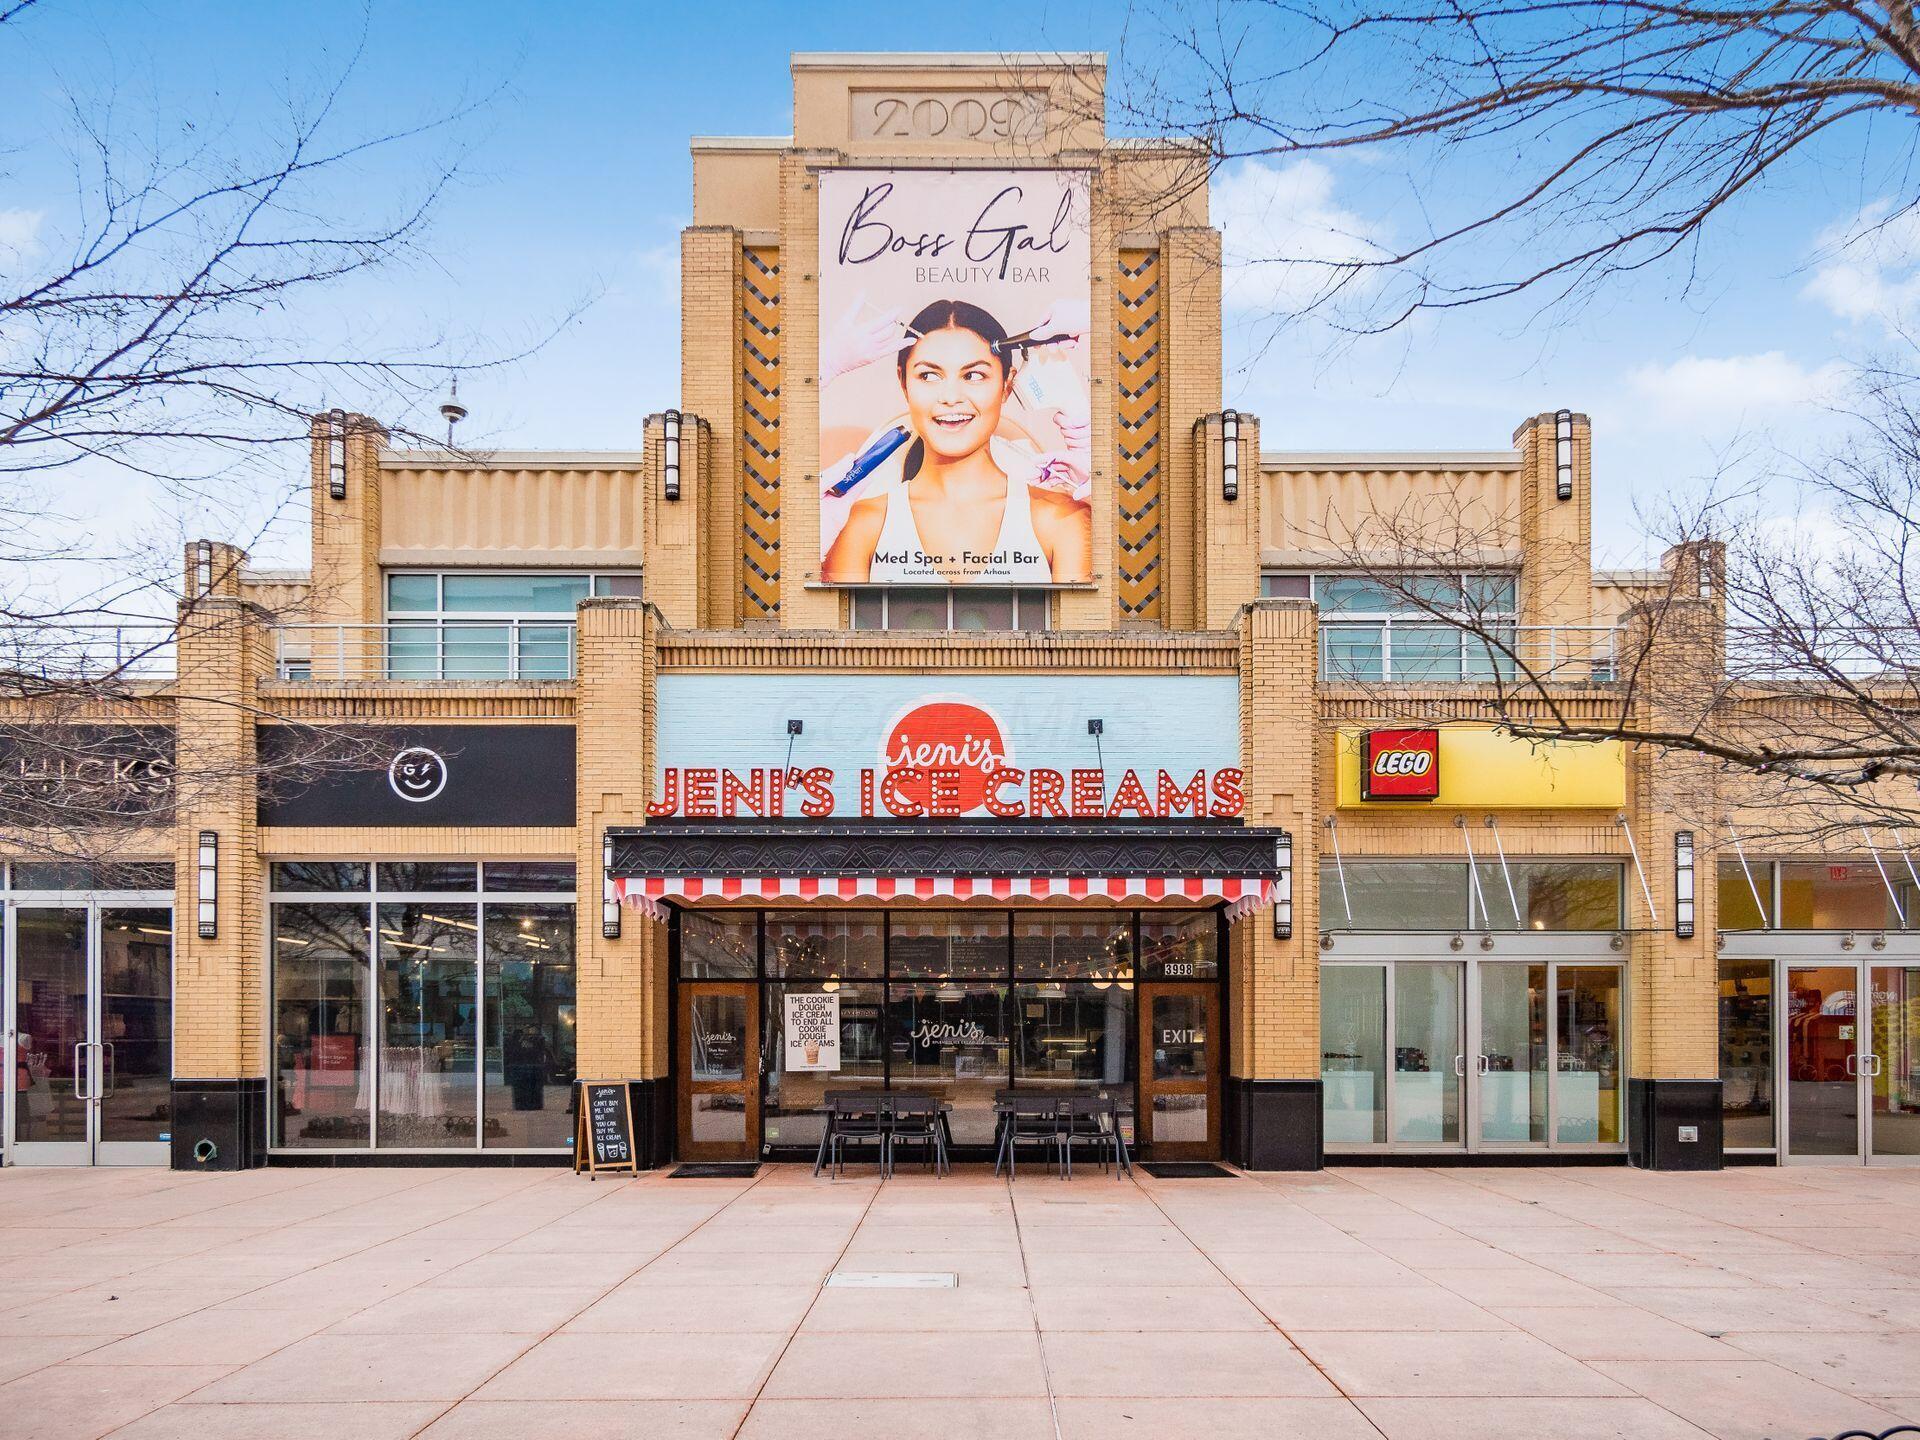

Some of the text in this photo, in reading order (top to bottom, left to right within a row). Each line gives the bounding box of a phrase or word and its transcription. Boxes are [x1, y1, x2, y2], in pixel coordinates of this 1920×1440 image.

[873, 99, 1025, 137] 2009
[838, 182, 1073, 281] Boss Gal
[915, 266, 1051, 283] BEAUTY BAR
[874, 550, 909, 564] Med
[914, 550, 943, 567] Spa
[962, 550, 1008, 564] Facial
[1013, 550, 1039, 564] Bar
[903, 567, 935, 576] Located
[962, 567, 982, 576] from
[983, 567, 1011, 576] Arhaus
[885, 734, 1007, 773] jeni's
[1375, 751, 1431, 775] LEGO
[645, 767, 1245, 818] JENI'S ICE CREAMS
[1166, 964, 1192, 975] 3998
[790, 996, 834, 1004] THE COOKIE
[798, 1003, 826, 1011] DOUGH
[791, 1018, 834, 1026] TO END ALL
[911, 1019, 984, 1047] jeni's
[1163, 1029, 1196, 1044] EXIT
